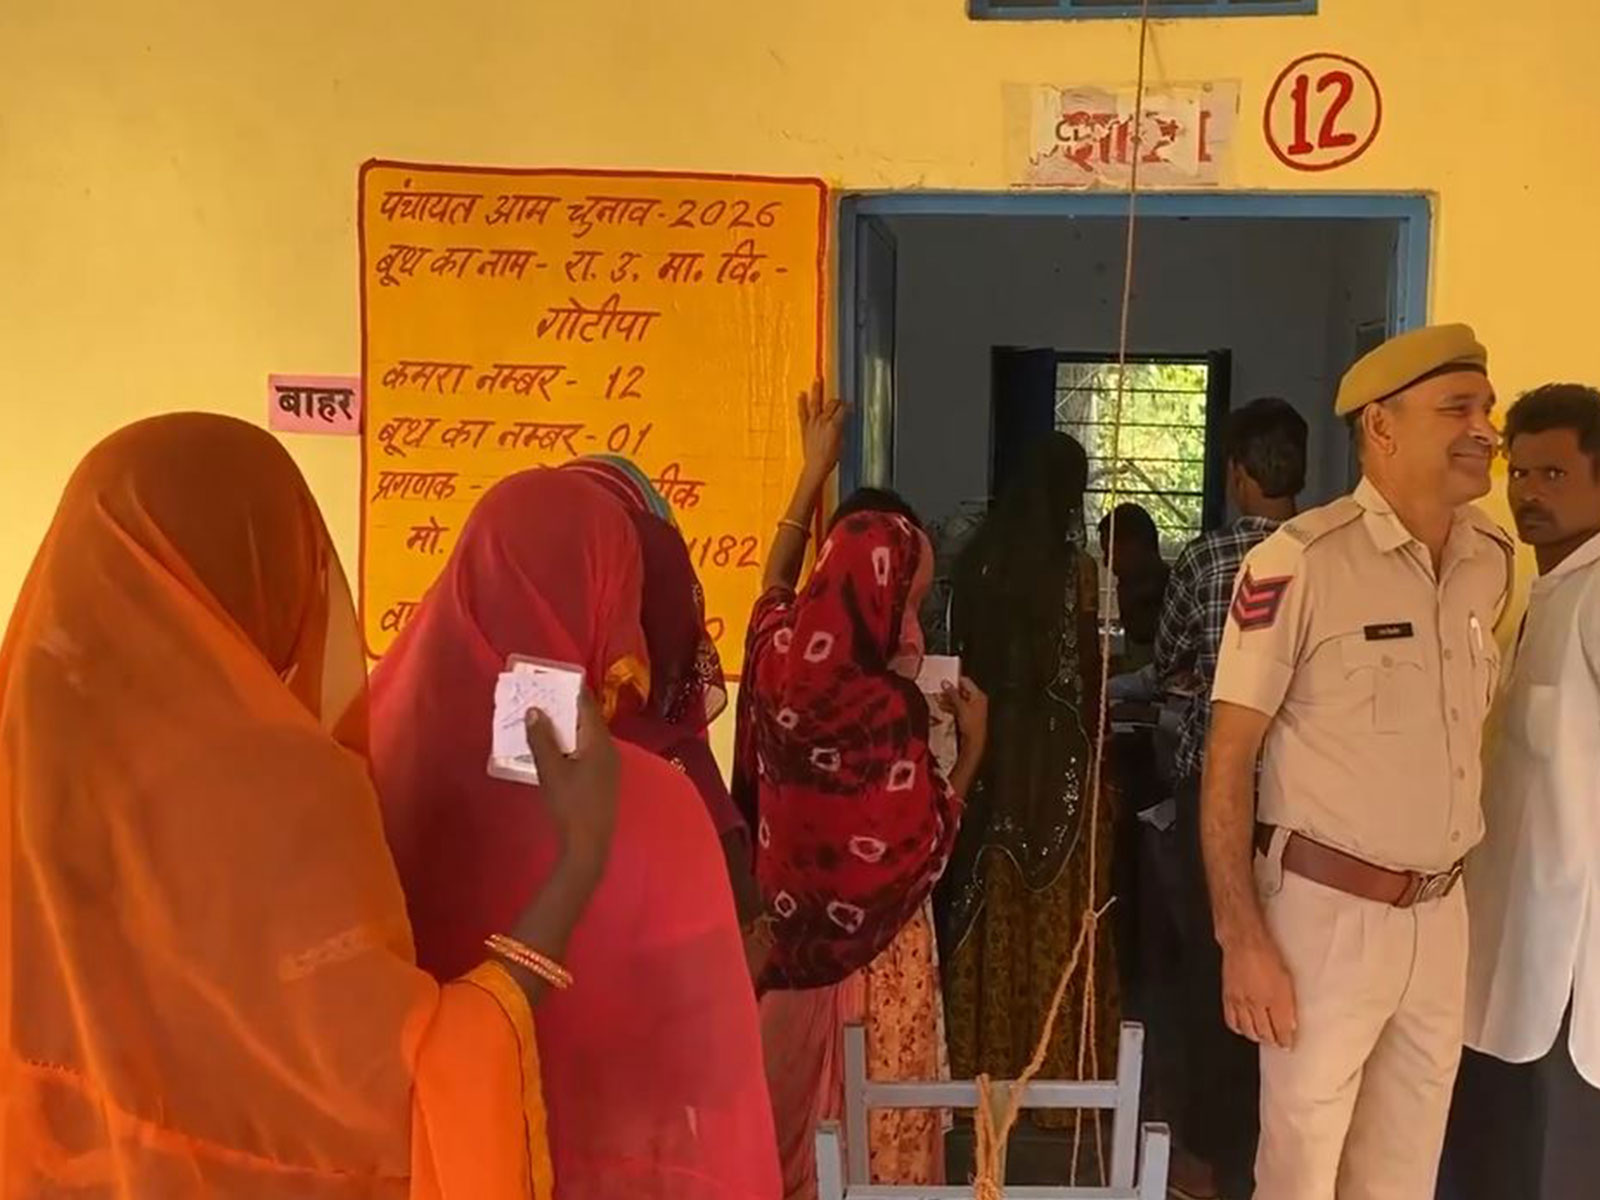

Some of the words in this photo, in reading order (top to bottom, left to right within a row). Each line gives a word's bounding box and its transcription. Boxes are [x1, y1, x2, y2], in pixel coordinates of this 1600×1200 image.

[1286, 70, 1357, 156] 12
[379, 177, 484, 226] पंचायत
[484, 193, 562, 226] आम
[375, 244, 432, 287] बूथ
[429, 247, 483, 279] का
[382, 360, 473, 394] कमरा
[605, 365, 645, 400] 12
[274, 384, 356, 423] बाहर
[378, 417, 441, 458] बूथ
[440, 419, 495, 450] का
[606, 423, 653, 454] 01
